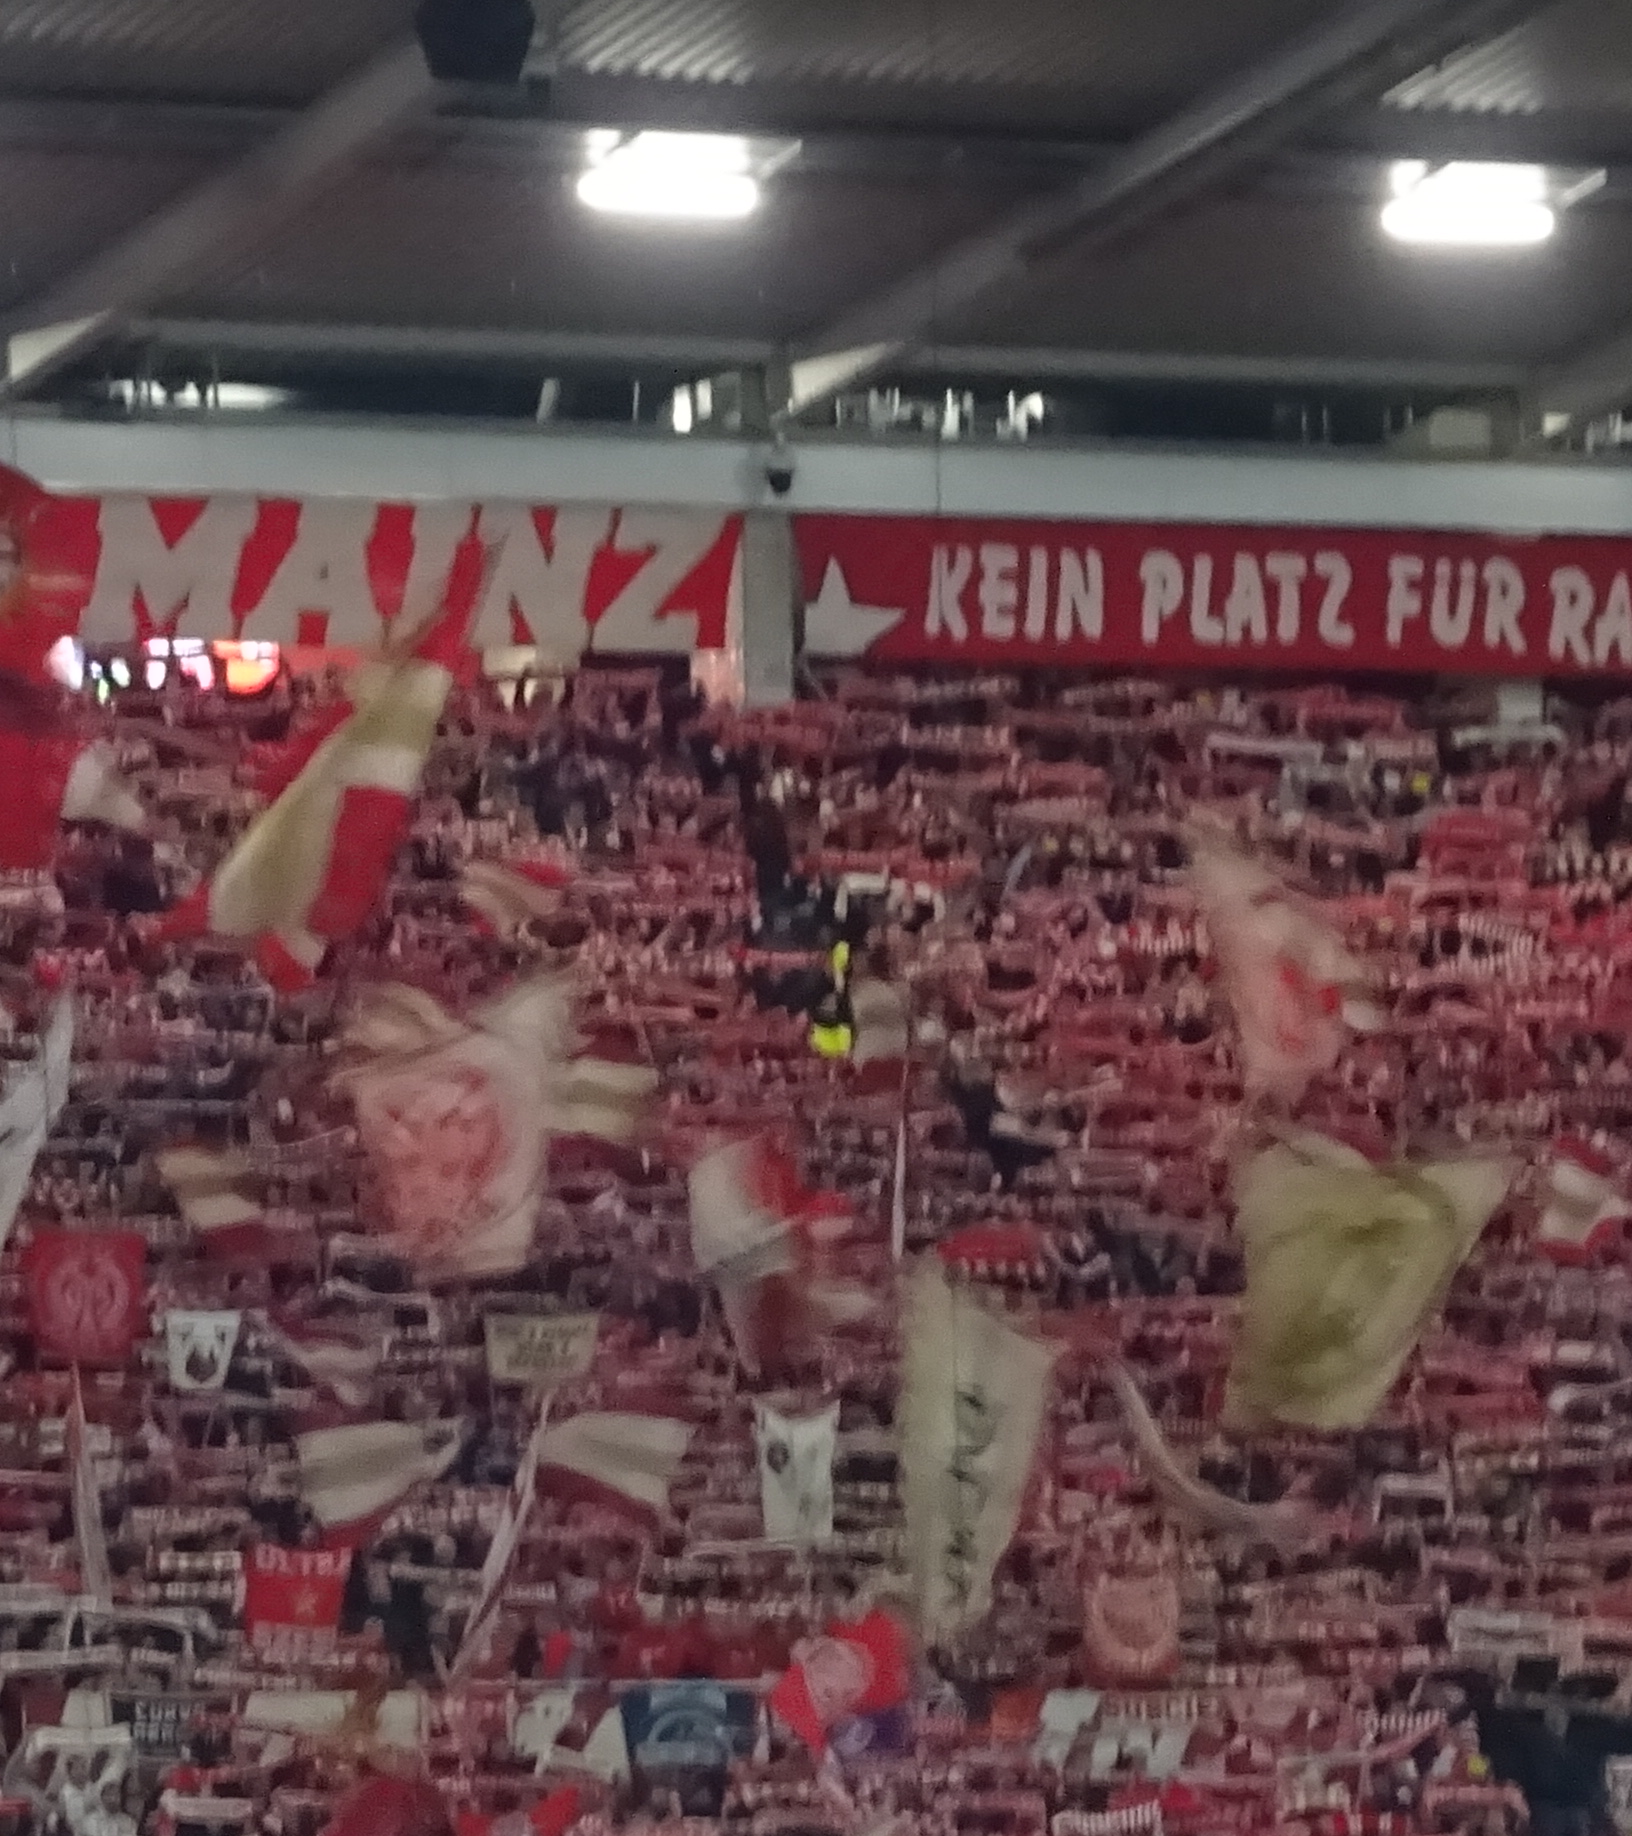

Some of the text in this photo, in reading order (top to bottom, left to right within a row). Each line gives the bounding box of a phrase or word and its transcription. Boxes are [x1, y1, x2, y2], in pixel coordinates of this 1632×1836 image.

[82, 492, 728, 650] MAINZ
[924, 545, 1103, 642] KEIN
[1141, 550, 1355, 648] PLATZ
